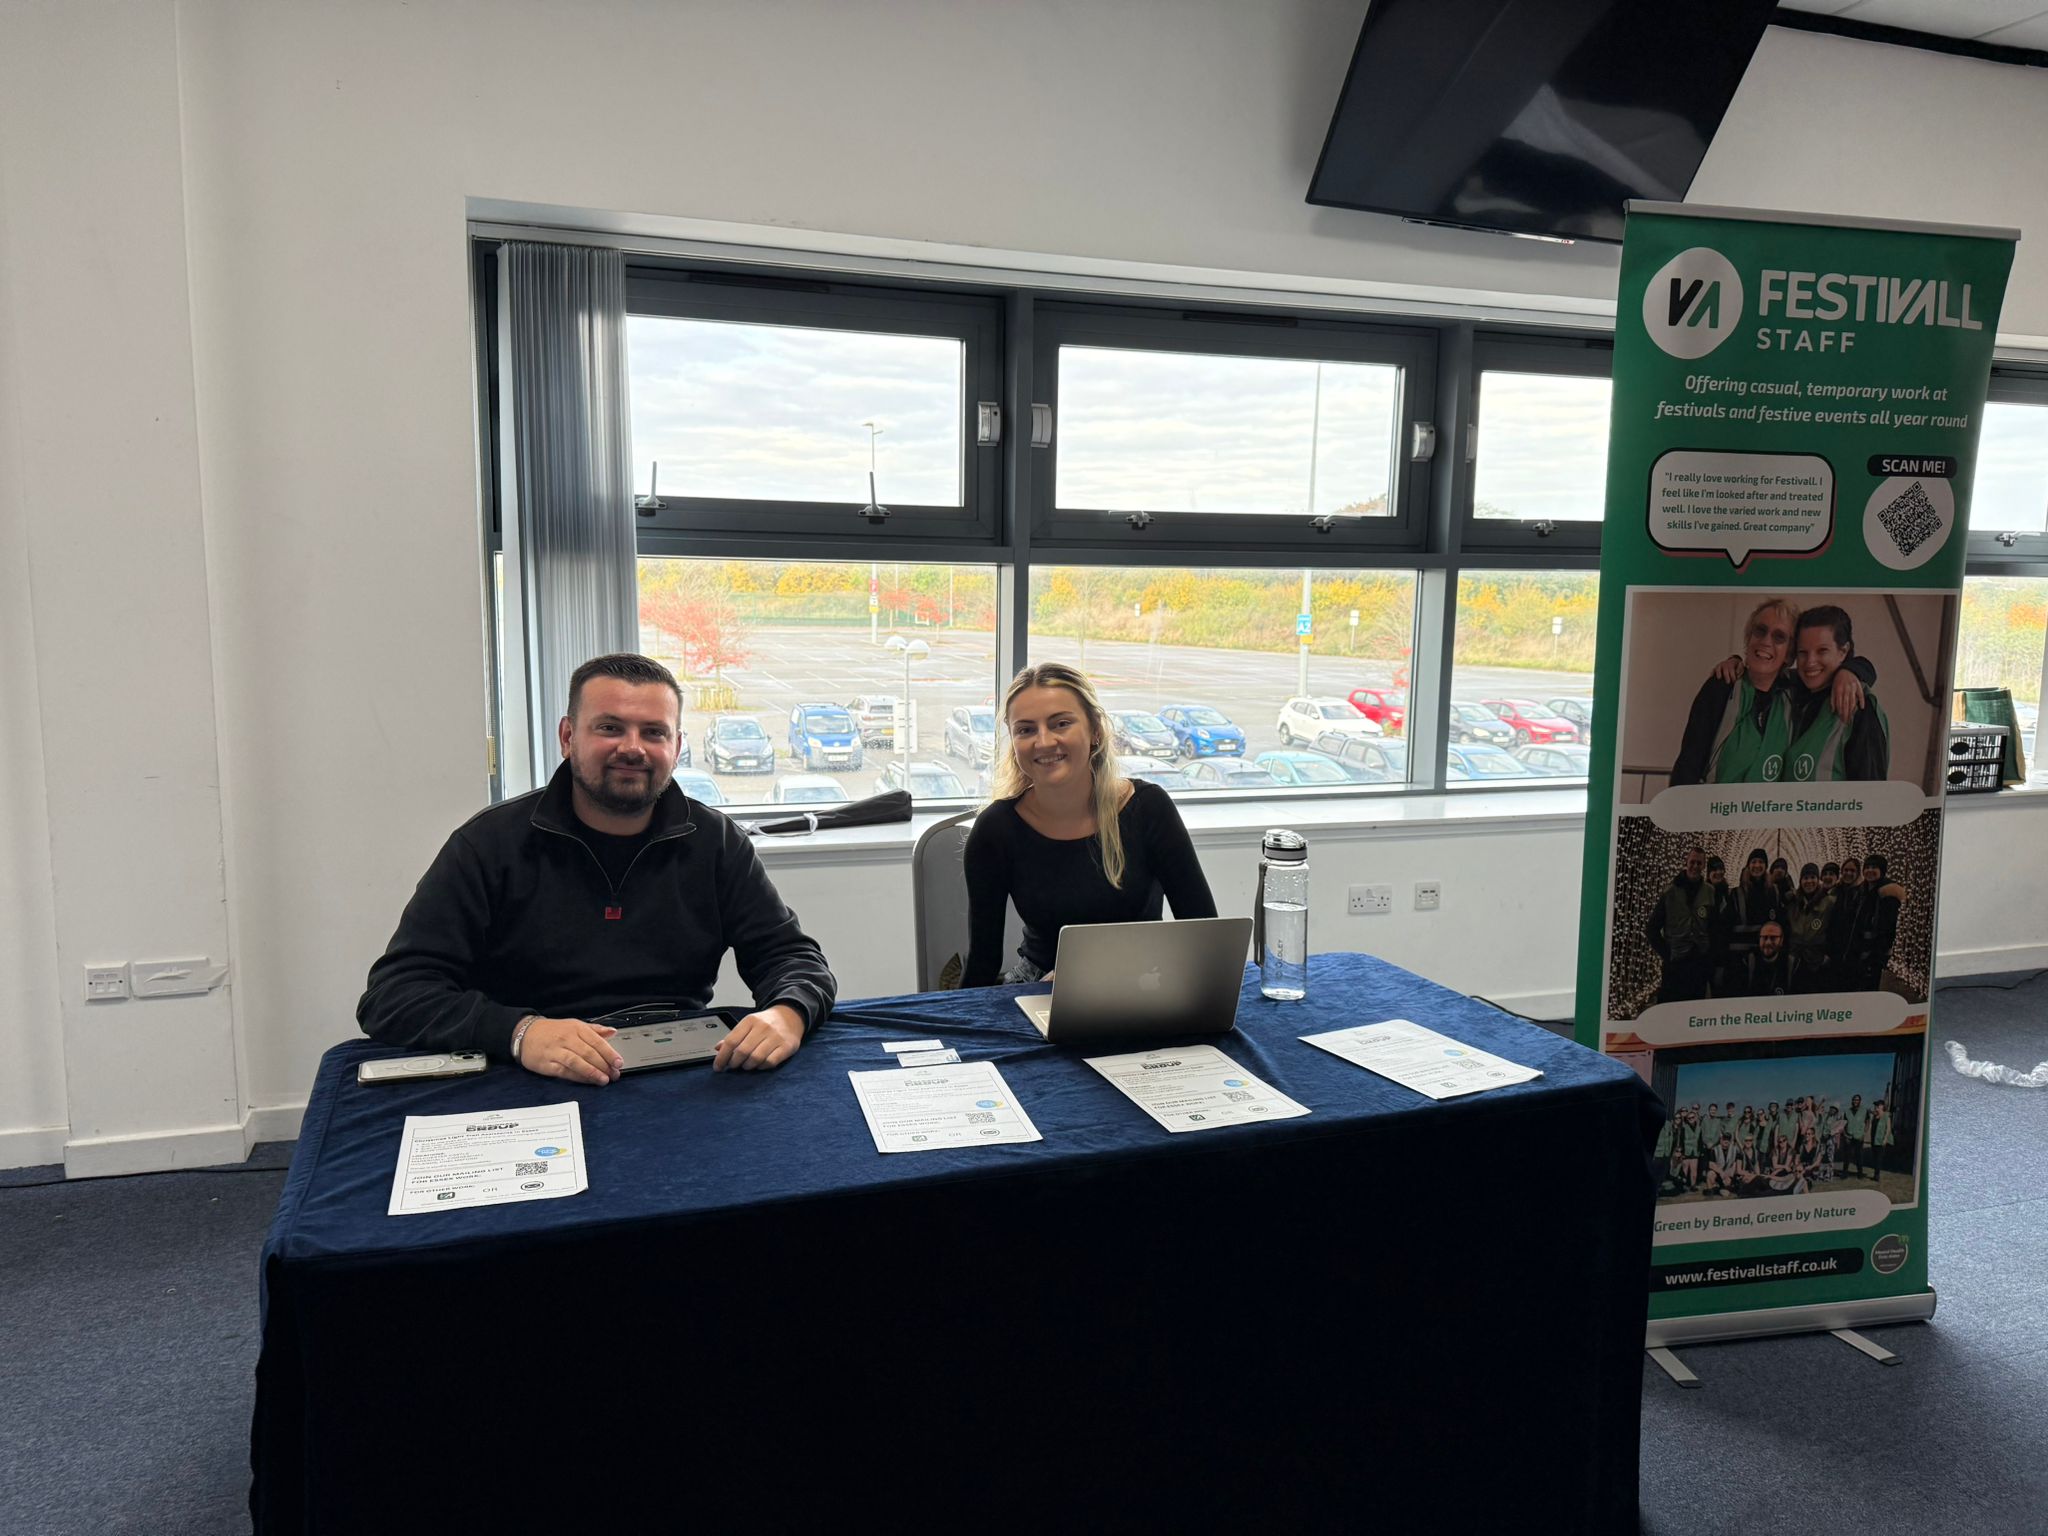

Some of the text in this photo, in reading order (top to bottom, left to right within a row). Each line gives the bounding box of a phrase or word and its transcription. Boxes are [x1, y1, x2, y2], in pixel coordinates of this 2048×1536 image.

[1759, 269, 1983, 330] FESTIVALL
[1756, 327, 1856, 353] STAFF
[1685, 375, 1948, 401] Offering casual, temporary work at
[1654, 401, 1969, 428] festivals and festive events all year round
[1882, 459, 1946, 474] SCAN ME!
[1674, 472, 1701, 484] really
[1703, 473, 1722, 483] love
[1724, 474, 1759, 486] working
[1760, 475, 1774, 485] for
[1775, 475, 1818, 486] Festivall.
[1819, 477, 1823, 486] I
[1662, 487, 1824, 501] feel like I'm looked after and treated
[1662, 504, 1822, 517] well. I love the varied work and new
[1667, 520, 1692, 530] skills
[1694, 520, 1710, 530] I've
[1710, 521, 1742, 532] gained.
[1743, 521, 1768, 532] Great
[1710, 799, 1863, 817] High Welfare Standards
[1688, 1008, 1853, 1028] Earn the Real Living Wage
[1653, 1206, 1856, 1232] Green by Brand, Green by Nature
[1665, 1257, 1838, 1285] www.festivallstaff.co.uk
